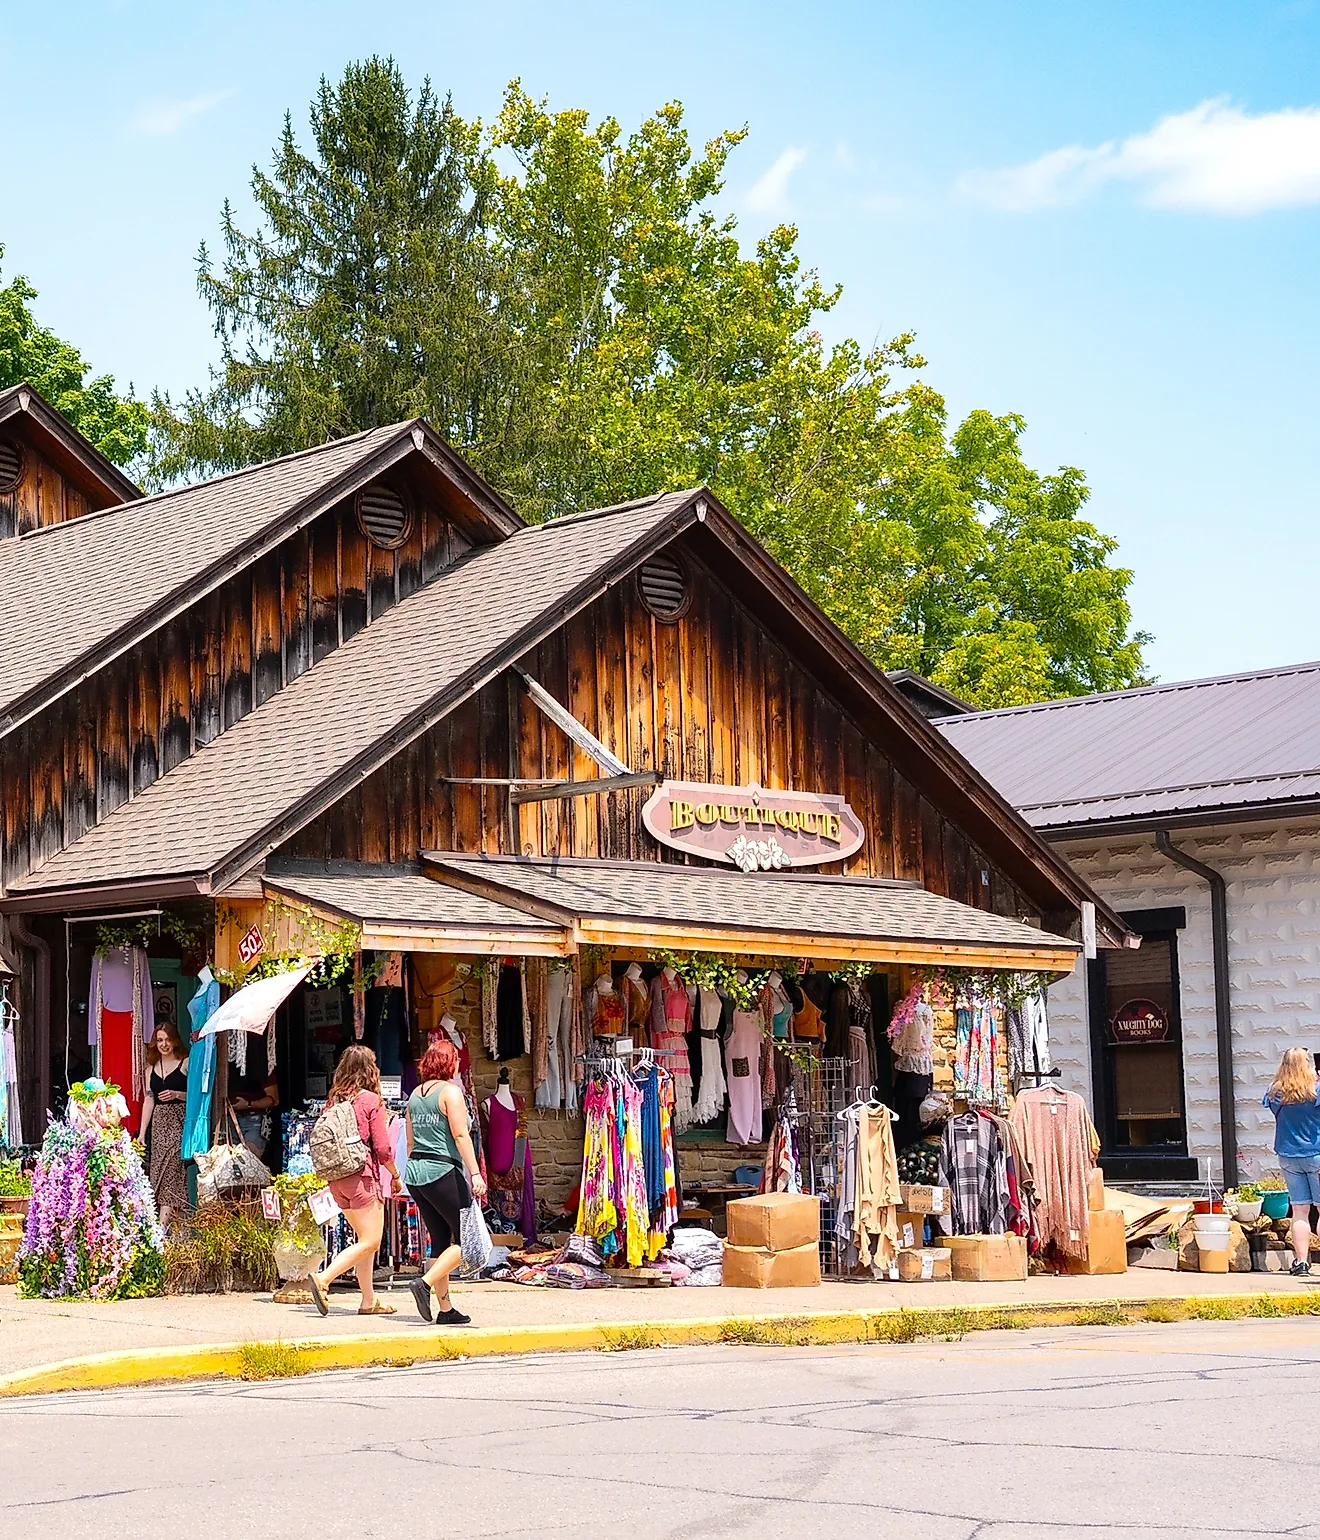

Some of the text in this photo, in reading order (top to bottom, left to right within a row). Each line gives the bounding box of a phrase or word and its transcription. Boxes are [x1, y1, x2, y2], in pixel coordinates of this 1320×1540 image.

[669, 800, 843, 844] BOUTIQUE
[1117, 1018, 1163, 1031] NAUGHTY DOG
[1130, 1029, 1152, 1037] BOOKS
